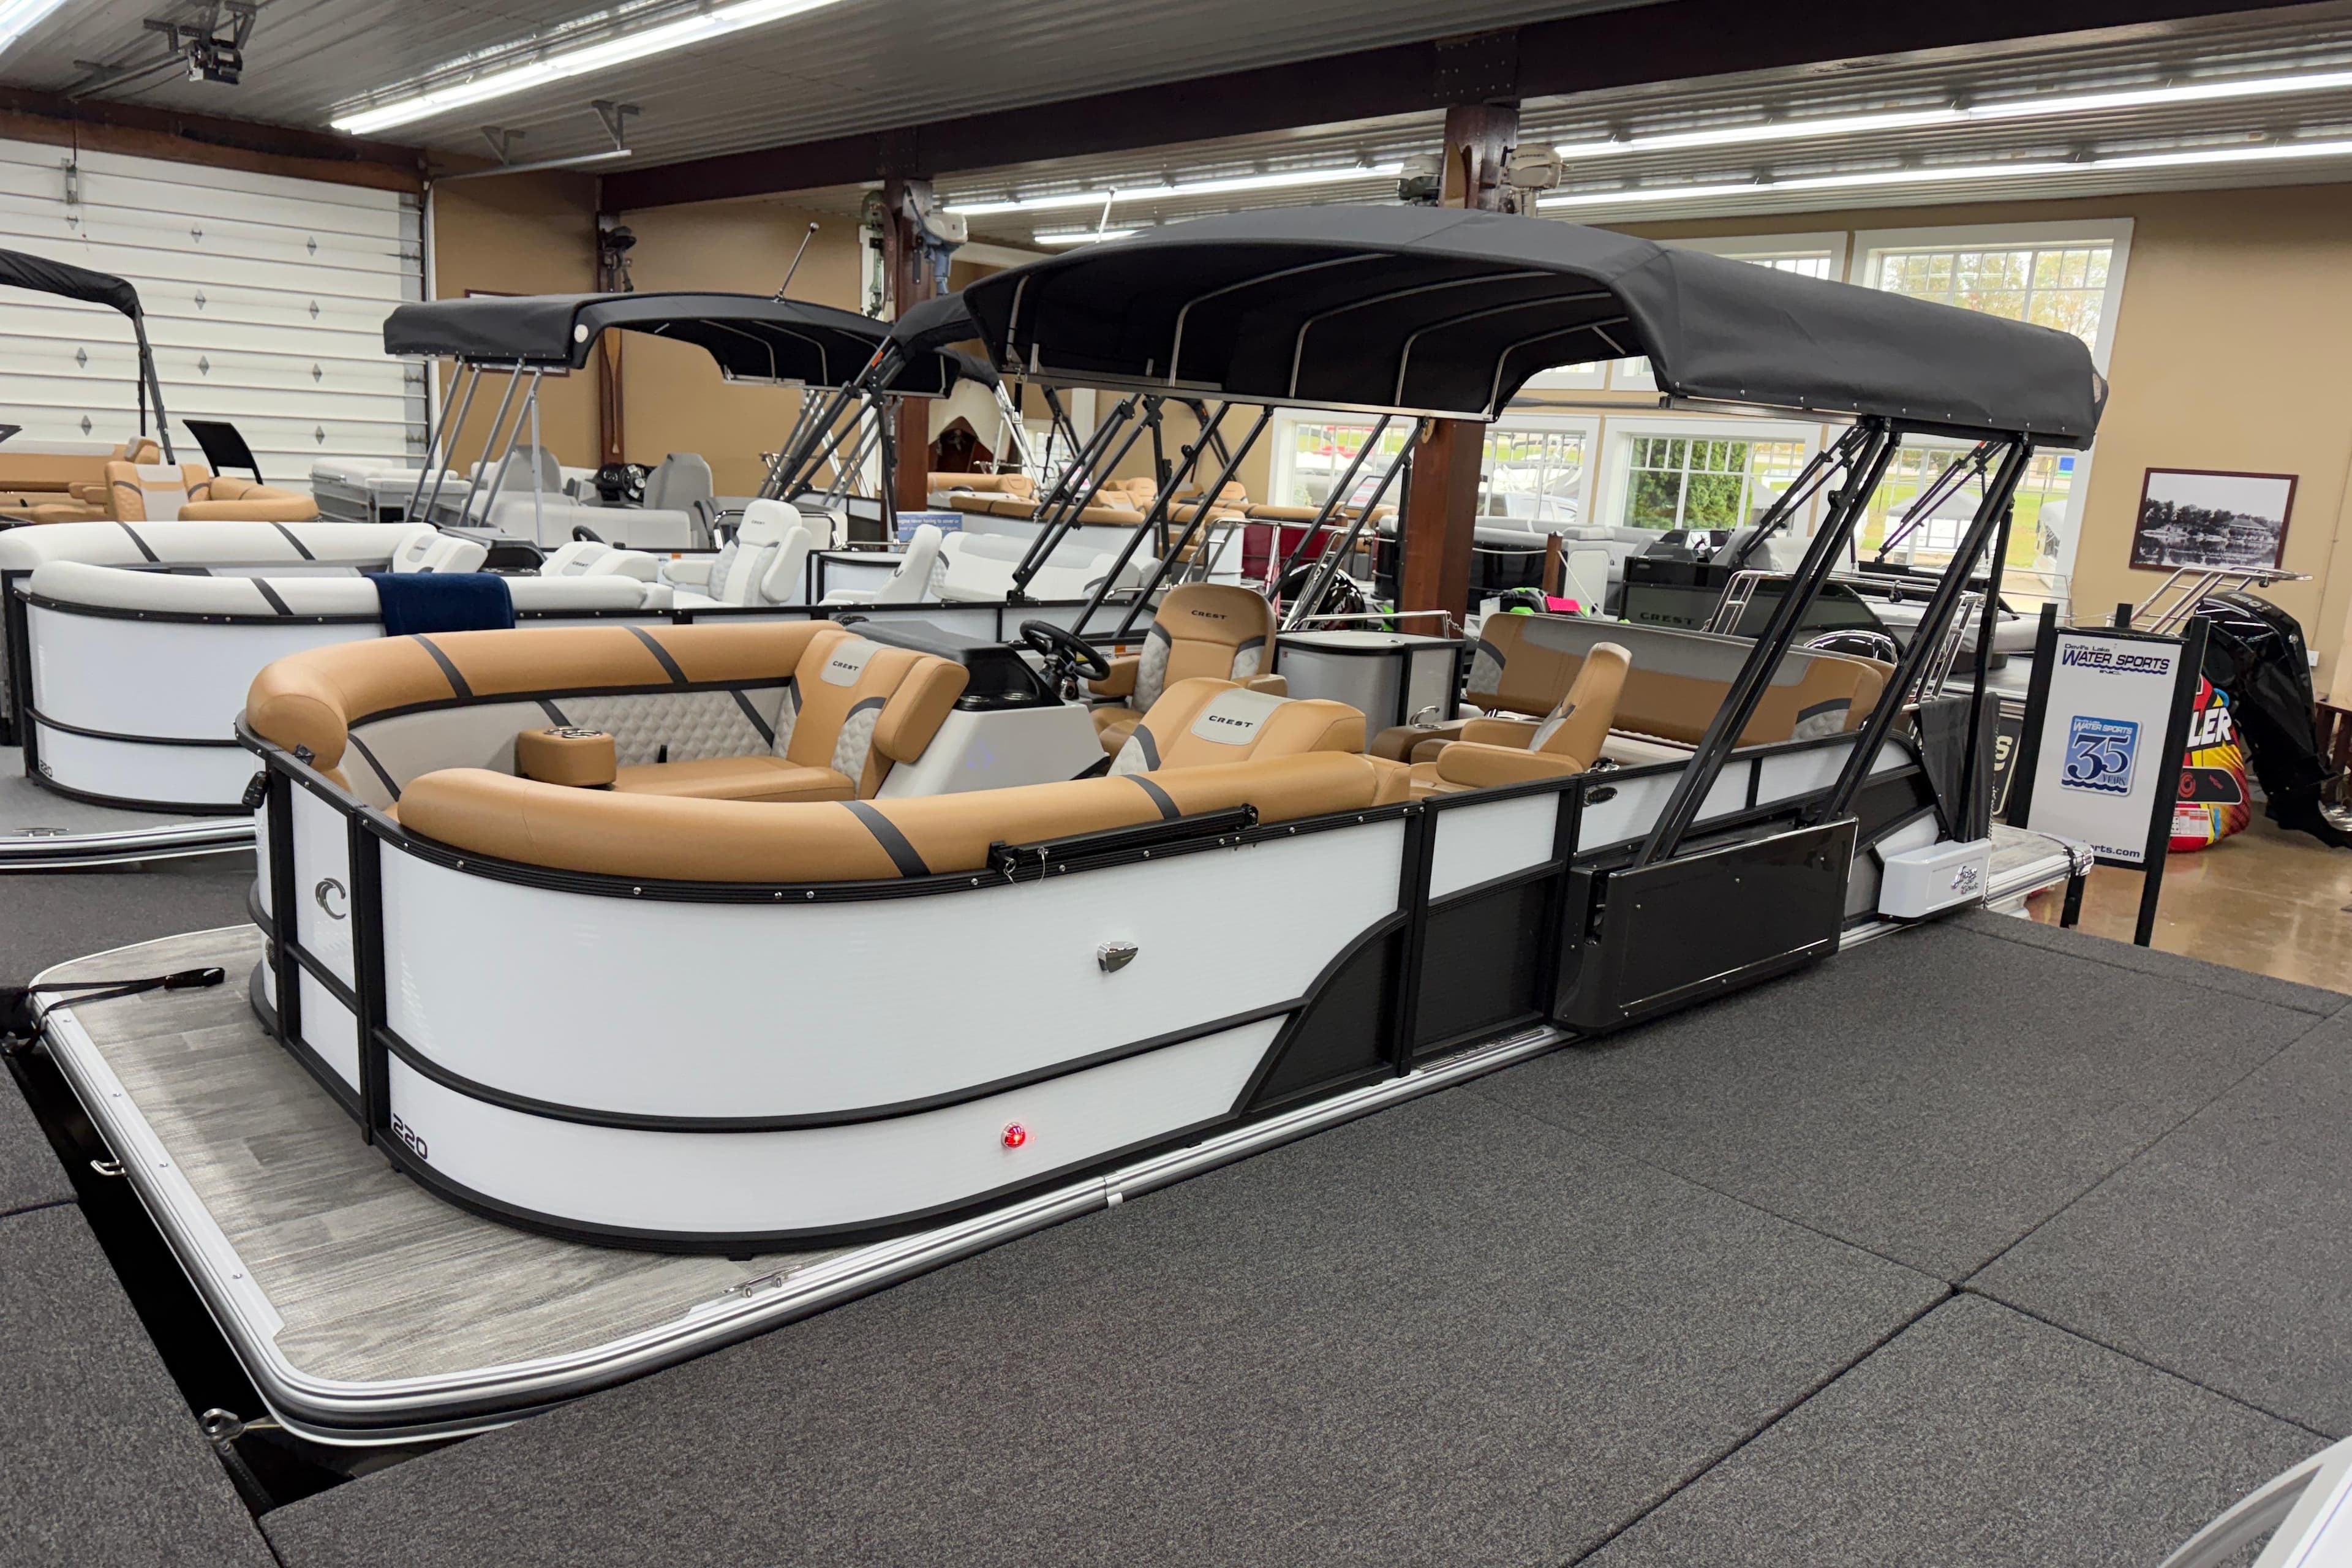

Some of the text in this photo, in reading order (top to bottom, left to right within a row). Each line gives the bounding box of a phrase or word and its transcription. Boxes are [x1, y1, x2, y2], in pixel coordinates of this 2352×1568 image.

[1191, 610, 1227, 619] CREST
[1640, 612, 1695, 625] CREST
[832, 660, 859, 671] CREST
[2062, 649, 2170, 670] WATER SPORTS
[1208, 715, 1254, 728] CREST
[2073, 721, 2133, 734] WATER SPORTS
[2187, 707, 2233, 748] LER
[2067, 734, 2129, 780] 35
[2090, 844, 2140, 858] rts.com
[393, 1112, 428, 1160] 220
